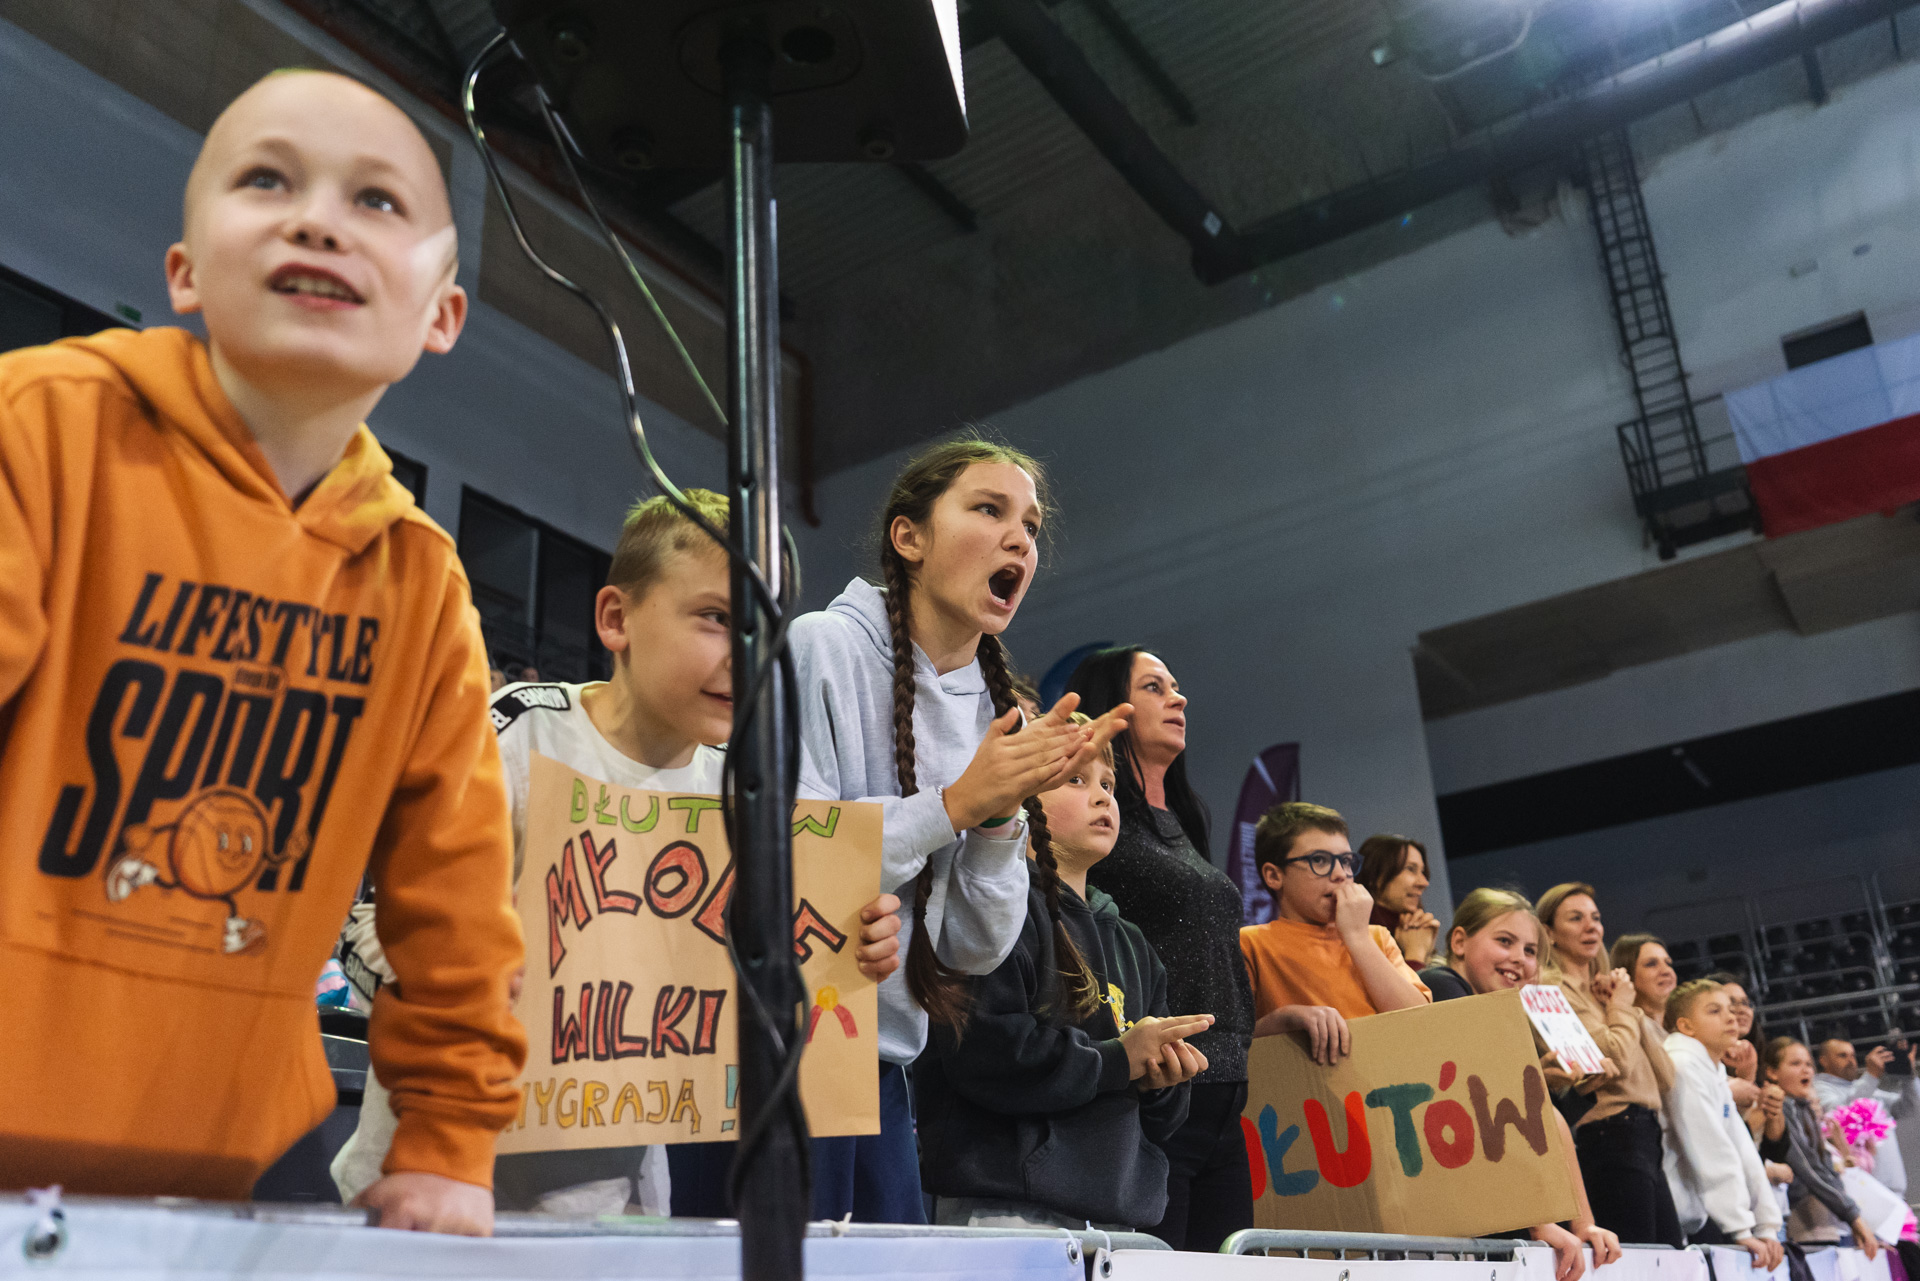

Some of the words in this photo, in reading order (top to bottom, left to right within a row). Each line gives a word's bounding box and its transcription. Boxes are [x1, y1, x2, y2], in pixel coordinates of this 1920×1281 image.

[119, 573, 379, 685] LIFESTYLE
[570, 778, 841, 838] DŁUTW
[552, 980, 727, 1065] WILKI
